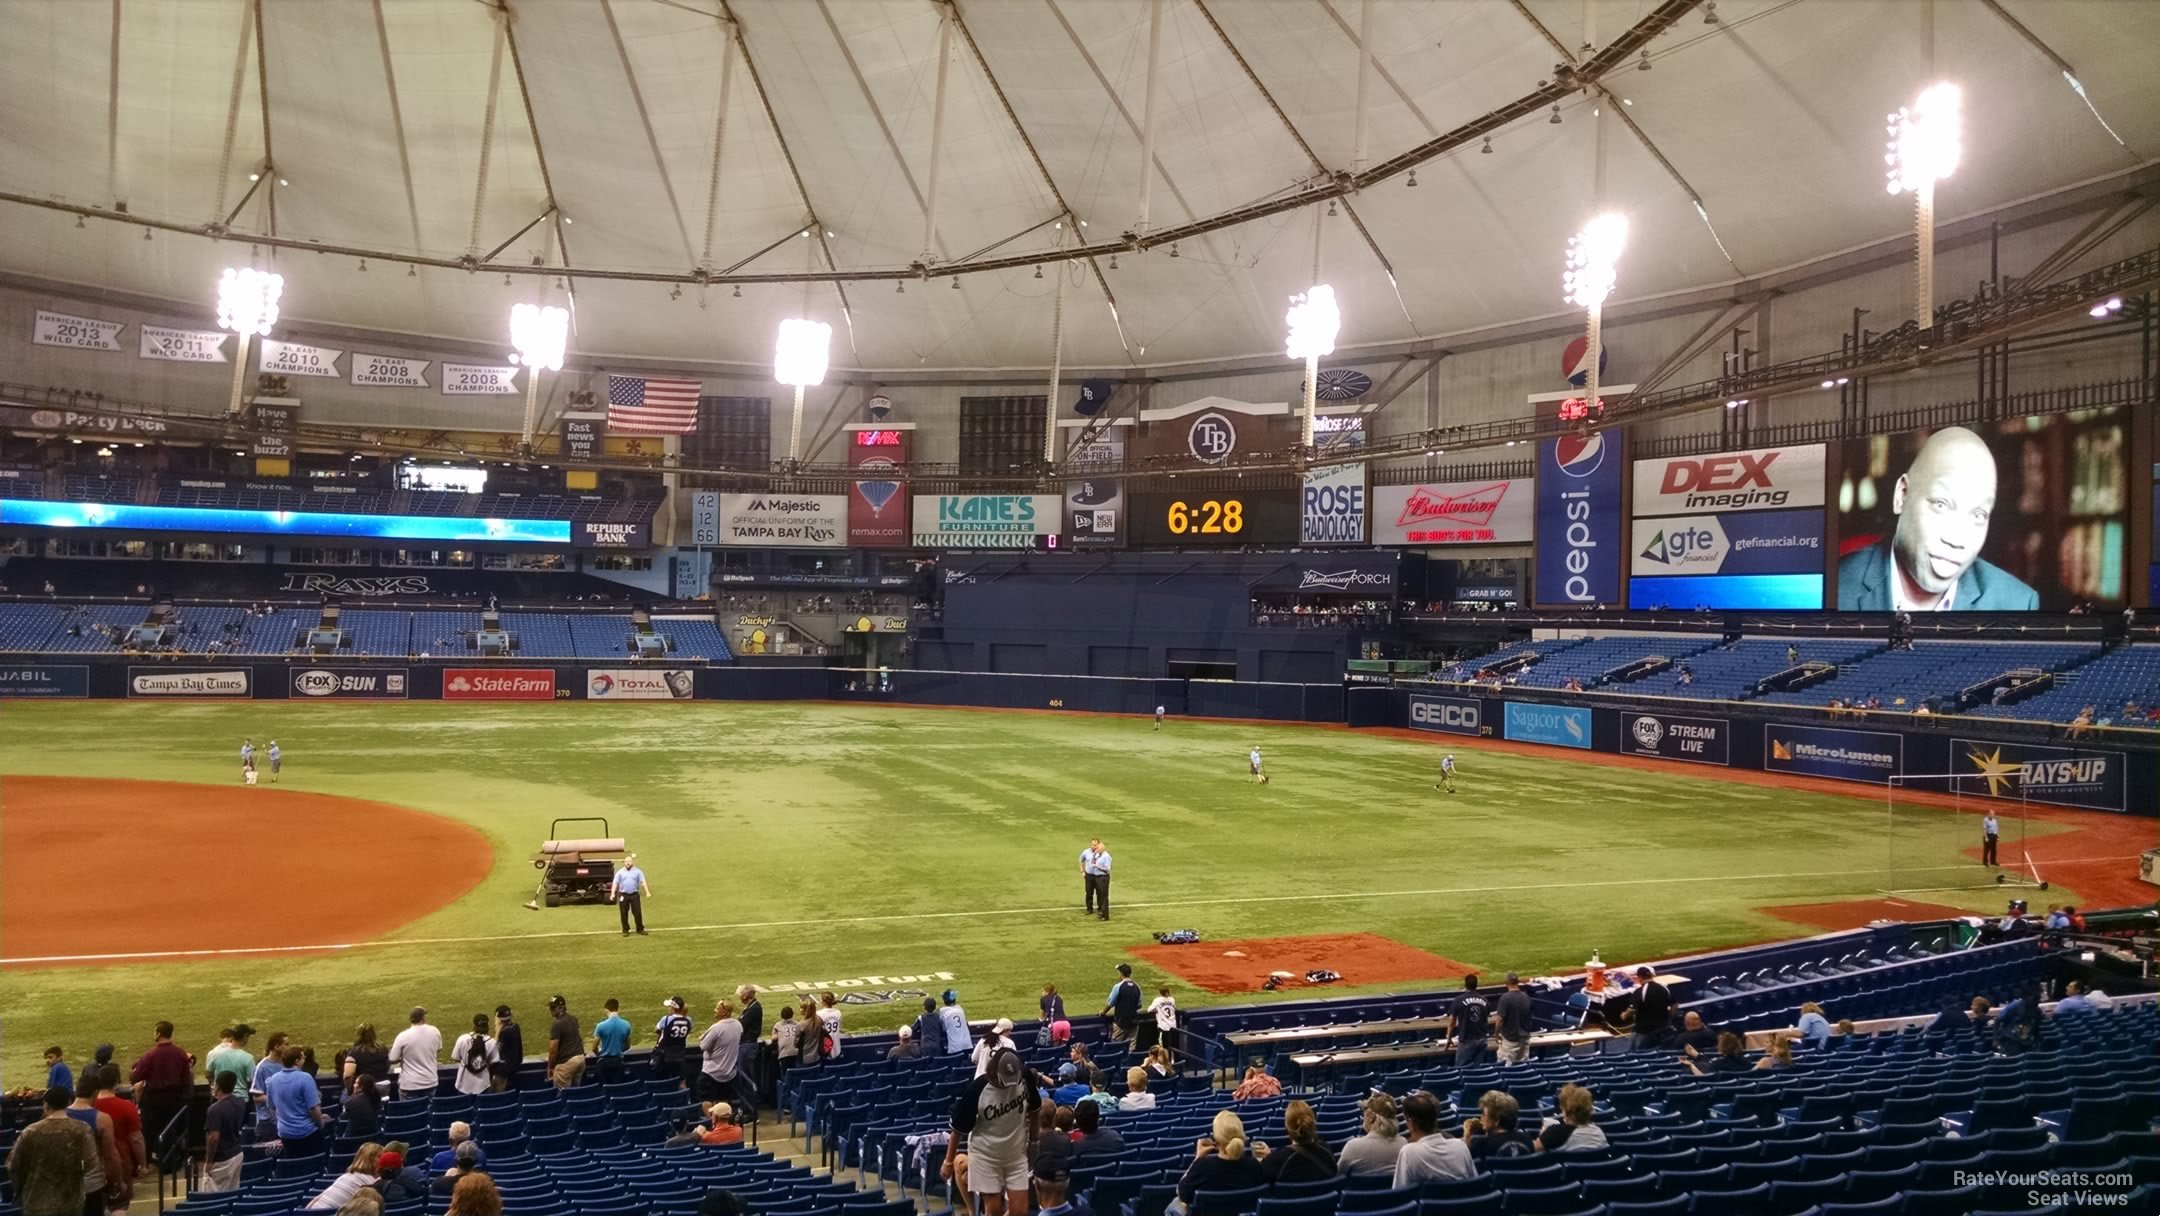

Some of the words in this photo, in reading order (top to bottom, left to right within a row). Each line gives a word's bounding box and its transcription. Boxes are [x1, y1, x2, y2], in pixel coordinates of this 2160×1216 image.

[57, 324, 100, 340] 2013
[43, 333, 72, 344] WILD
[77, 338, 109, 349] CARD
[163, 338, 203, 351] 2011
[150, 347, 178, 358] WILD
[182, 350, 213, 360] CARD
[283, 345, 294, 353] AL
[296, 346, 317, 354] EAST
[279, 352, 319, 366] 2010
[266, 361, 329, 375] CHAMPIONS
[369, 364, 409, 377] 2008
[357, 374, 418, 385] CHAMPIONS
[460, 374, 498, 385] 2008
[448, 384, 508, 393] CHAMPIONS
[568, 422, 590, 432] Fast
[261, 436, 282, 445] the
[567, 432, 595, 441] news
[1198, 423, 1228, 454] TB
[254, 444, 289, 455] buzz?
[571, 441, 590, 450] you
[1660, 452, 1782, 495] DEX
[697, 495, 714, 508] 42
[1304, 485, 1363, 515] ROSE
[1685, 489, 1790, 508] imaging
[769, 500, 821, 514] Majestic
[939, 496, 1035, 521] KANE'S
[1406, 497, 1496, 517] Budweiser
[699, 512, 711, 525] 12
[732, 516, 767, 524] OFFICIAL
[768, 517, 805, 525] UNIFORM
[1096, 514, 1112, 522] NEW
[1167, 500, 1243, 534] 6:28
[586, 523, 636, 534] REPUBLIC
[732, 527, 775, 538] TAMPA
[778, 527, 802, 538] BAY
[851, 528, 903, 536] remax.com
[942, 523, 1030, 531] FURNITURE
[1303, 515, 1363, 541] RADIOLOGY
[596, 533, 626, 543] BANK
[697, 529, 714, 542] 66
[1407, 531, 1427, 541] THIS
[1456, 529, 1474, 540] FOR
[1561, 491, 1597, 601] pepsi
[1669, 527, 1713, 557] gte
[1735, 536, 1819, 551] gtefinancial.org
[1678, 551, 1719, 566] financial
[1305, 573, 1352, 584] Budweiser
[1351, 574, 1390, 585] PORCH
[739, 615, 776, 627] Ducky's
[139, 679, 180, 692] Tampa
[180, 678, 204, 692] Bay
[206, 677, 242, 690] Times
[305, 677, 330, 687] FOX
[341, 676, 377, 692] SUN
[556, 689, 571, 697] 370
[1049, 699, 1063, 708] 404
[1411, 701, 1478, 728] GEICO
[1512, 705, 1561, 732] Sagicor
[1481, 726, 1493, 735] 370
[1639, 722, 1656, 734] FOX
[1669, 724, 1715, 740] STREAM
[1681, 740, 1704, 753] LIVE
[1796, 744, 1893, 763] MicroLumen
[2019, 763, 2072, 784] RAYS
[2076, 761, 2106, 782] UP
[1164, 1007, 1171, 1018] 3
[826, 1021, 838, 1034] 39
[953, 1015, 962, 1028] 3
[670, 1025, 688, 1038] 39
